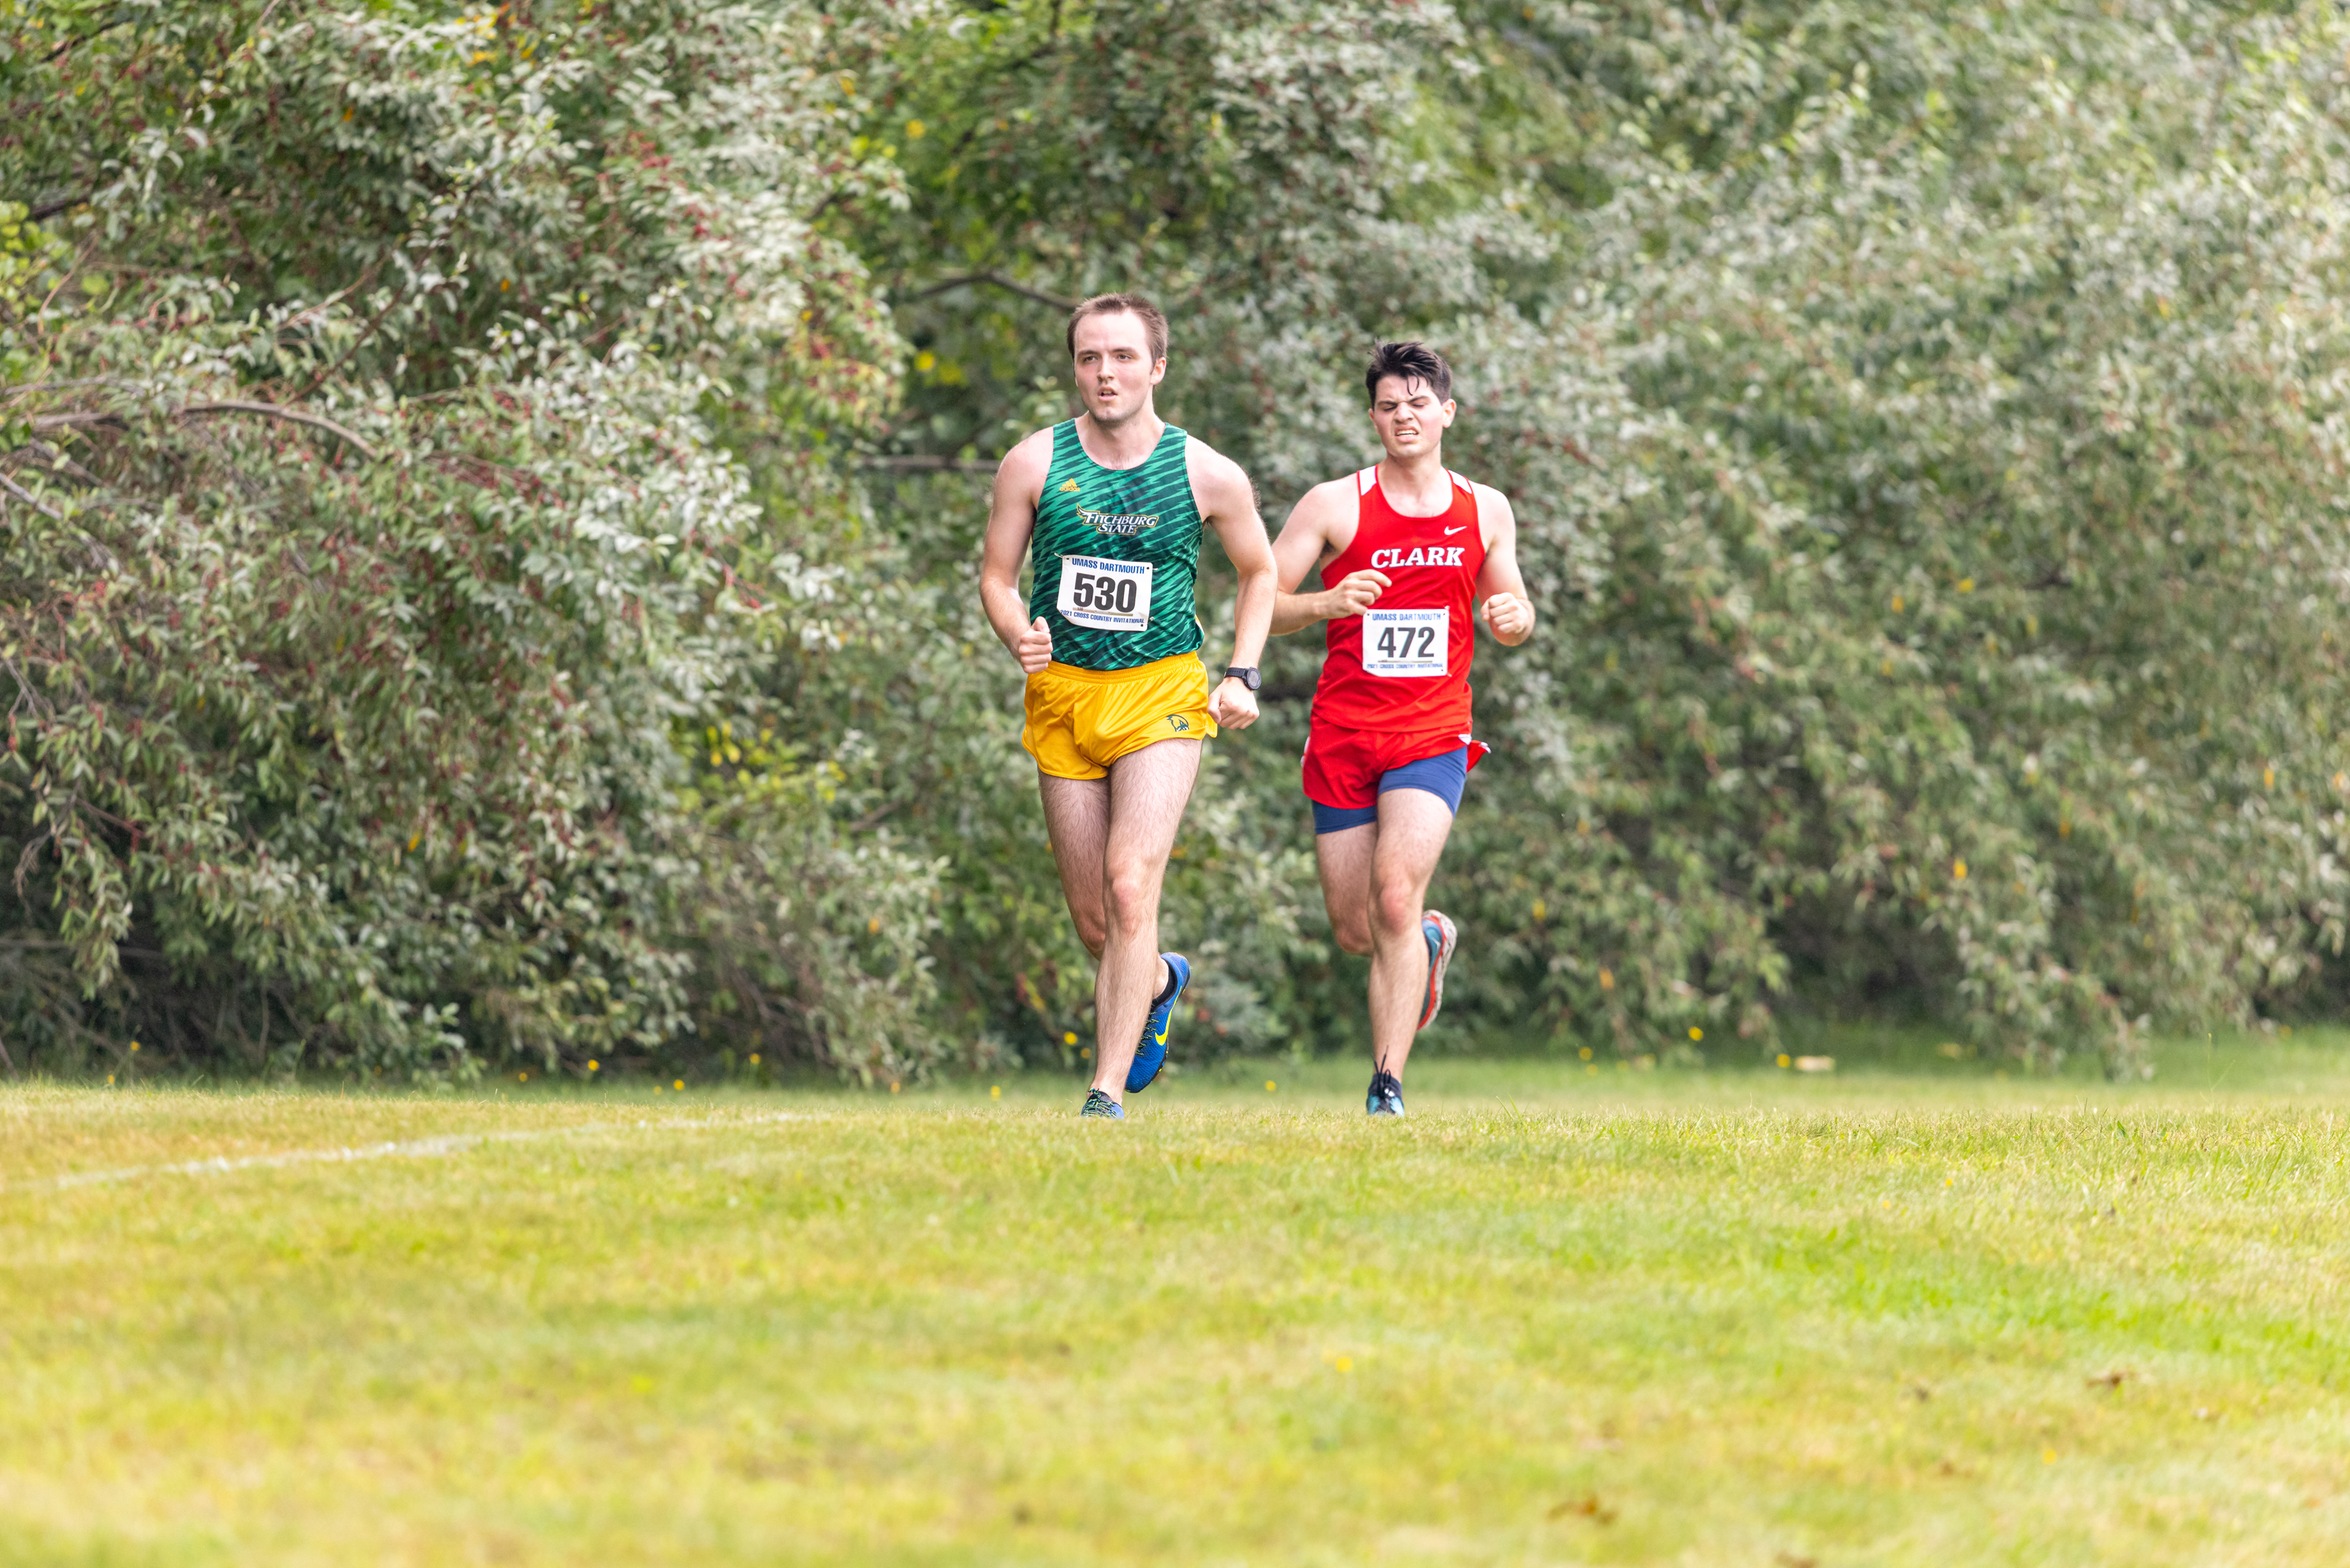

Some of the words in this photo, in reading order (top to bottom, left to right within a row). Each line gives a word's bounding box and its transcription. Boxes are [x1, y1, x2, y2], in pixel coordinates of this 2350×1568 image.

[1081, 510, 1157, 526] FITCHBURG
[1098, 523, 1137, 534] STATE
[1371, 546, 1465, 569] CLARK
[1071, 558, 1098, 570] UMASS
[1100, 562, 1145, 574] DARTMOUTH
[1073, 572, 1138, 613] 530
[1372, 613, 1397, 621] UMASS
[1399, 613, 1442, 621] DARTMOUTH
[1377, 626, 1435, 658] 472
